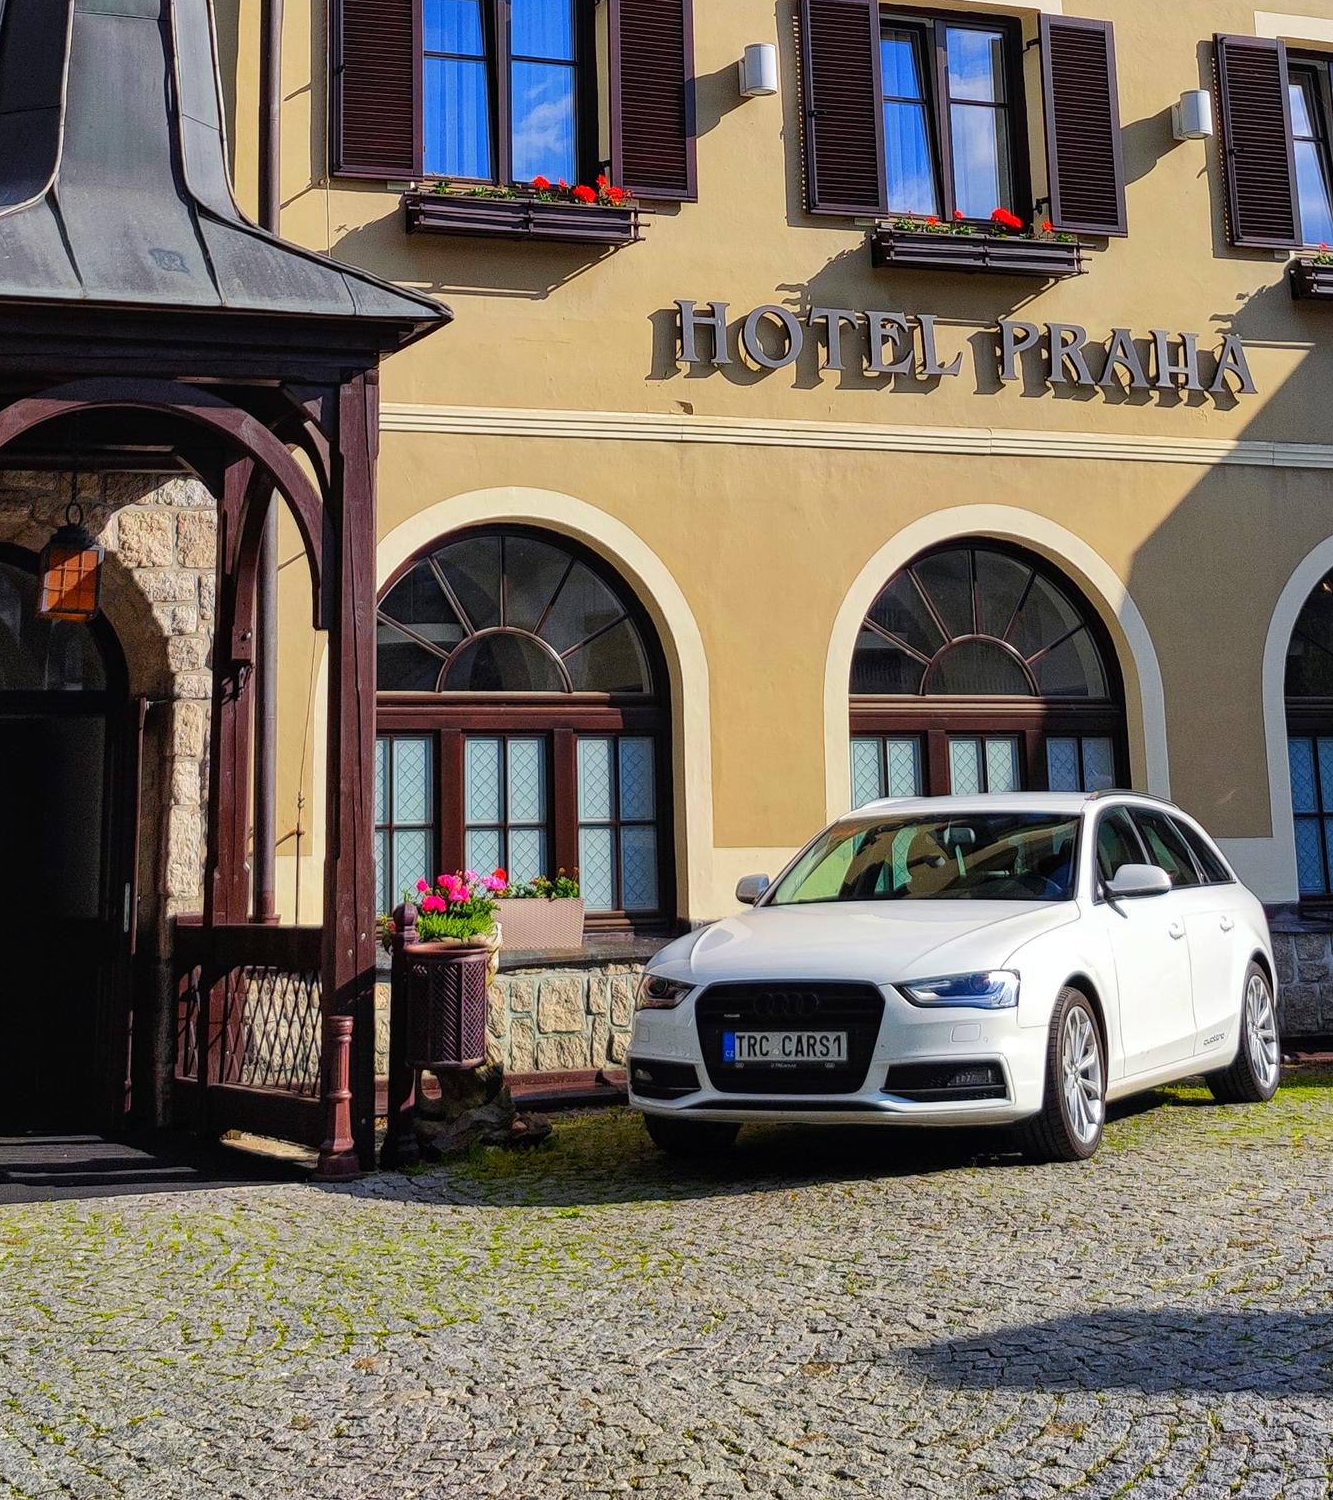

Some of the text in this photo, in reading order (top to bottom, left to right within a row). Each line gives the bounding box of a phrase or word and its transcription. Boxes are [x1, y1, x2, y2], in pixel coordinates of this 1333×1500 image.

[672, 299, 1260, 394] HOTEL PRAHA
[725, 1035, 842, 1058] CZ TRC CARS1
